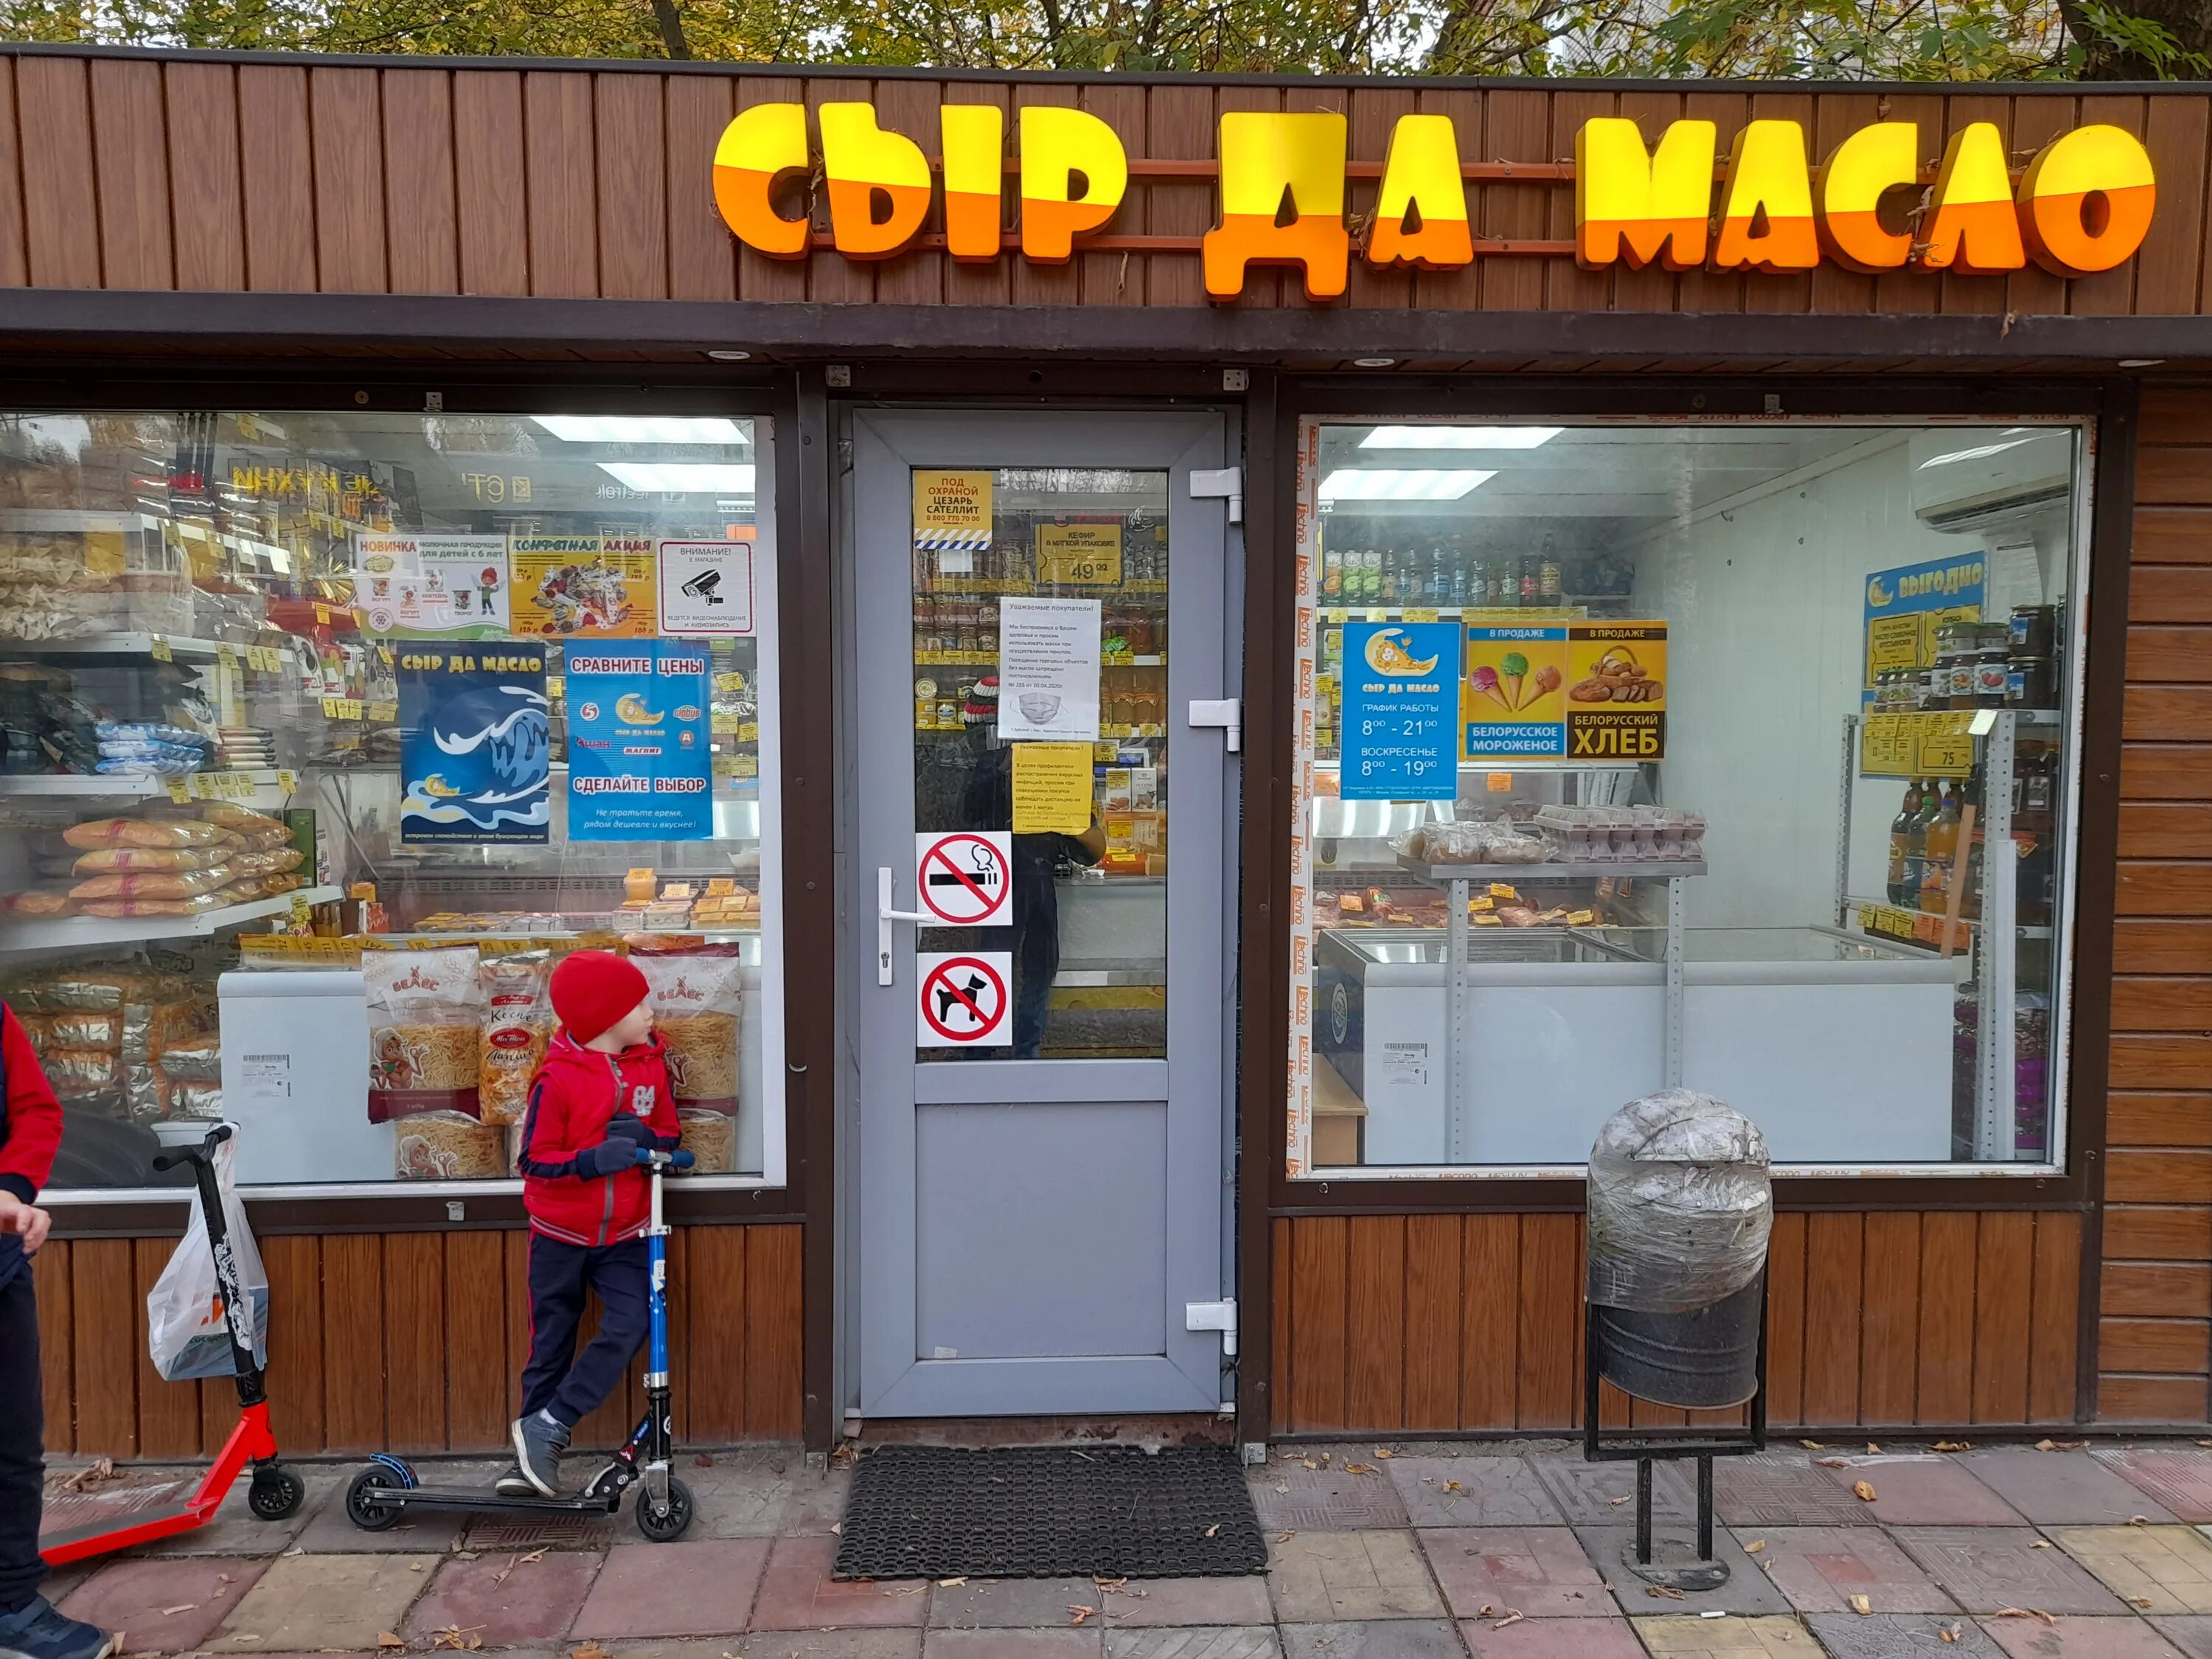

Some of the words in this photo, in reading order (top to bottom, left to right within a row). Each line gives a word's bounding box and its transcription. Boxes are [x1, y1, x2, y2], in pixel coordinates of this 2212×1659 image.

[713, 102, 1127, 264] СЫР
[1201, 112, 1473, 302] ДА
[1576, 117, 2156, 279] МАСЛО
[942, 478, 964, 487] ПОД
[928, 486, 978, 495] ОХРАНОЙ
[933, 496, 973, 505] ЦЕЗАРЬ
[926, 506, 979, 514] САТЕЛЛИТ
[360, 541, 417, 552] НОВИНКА
[604, 540, 653, 553] АКЦИЯ
[1498, 629, 1545, 639] ПРОДАЖЕ
[1598, 630, 1645, 639] ПРОДАЖЕ
[401, 655, 442, 670] СЫР
[448, 655, 476, 673] ДА
[481, 656, 543, 672] МАСЛО
[571, 658, 650, 673] СРАВНИТЕ
[658, 659, 703, 675] ЦЕНЫ
[1363, 684, 1385, 693] СЫР
[1388, 684, 1403, 694] ДА
[1400, 704, 1439, 712] РАБОТЫ
[1574, 713, 1658, 726] БЕЛОРУССКИЙ
[1473, 727, 1557, 737] БЕЛОРУССКОЕ
[1473, 740, 1557, 751] МОРОЖЕНОЕ
[1573, 728, 1658, 754] ХЛЕБ
[1361, 748, 1438, 757] ВОСКРЕСЕНЬЕ
[1943, 752, 1955, 765] 75
[574, 776, 648, 793] СДЕЛАЙТЕ
[655, 779, 705, 791] ВЫБОР
[609, 810, 653, 818] тратьте
[655, 810, 684, 818] время,
[584, 821, 611, 829] рядом
[660, 821, 696, 829] вкуснее!
